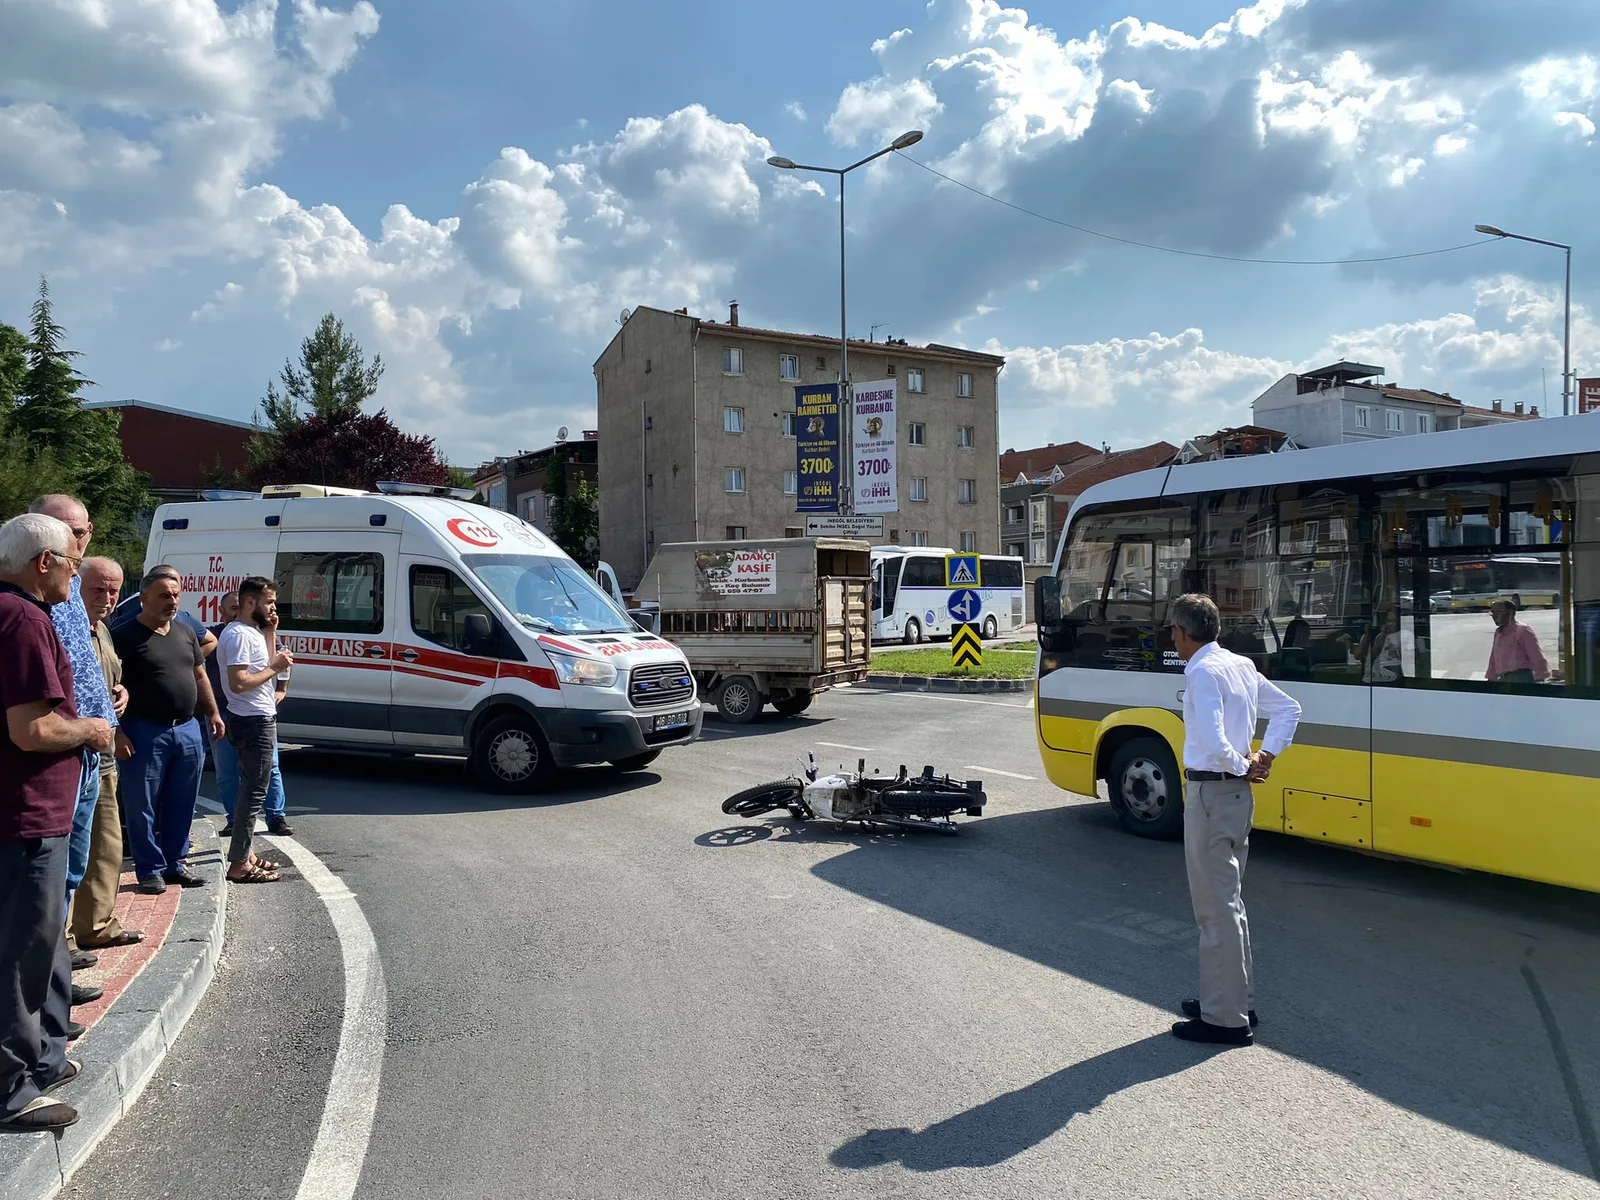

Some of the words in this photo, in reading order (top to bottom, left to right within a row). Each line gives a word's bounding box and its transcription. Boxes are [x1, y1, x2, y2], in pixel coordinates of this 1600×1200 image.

[803, 394, 832, 404] KURBAN
[855, 390, 893, 403] KARDEŞİNE
[798, 404, 837, 416] RAHMETTİR
[856, 403, 884, 414] KURBAN
[884, 402, 893, 412] OL
[467, 525, 498, 539] 112
[735, 552, 775, 562] ADAKÇI
[209, 556, 224, 573] T.C.
[737, 563, 772, 575] KAŞİF
[197, 595, 224, 622] 11
[1163, 650, 1180, 658] OTOK
